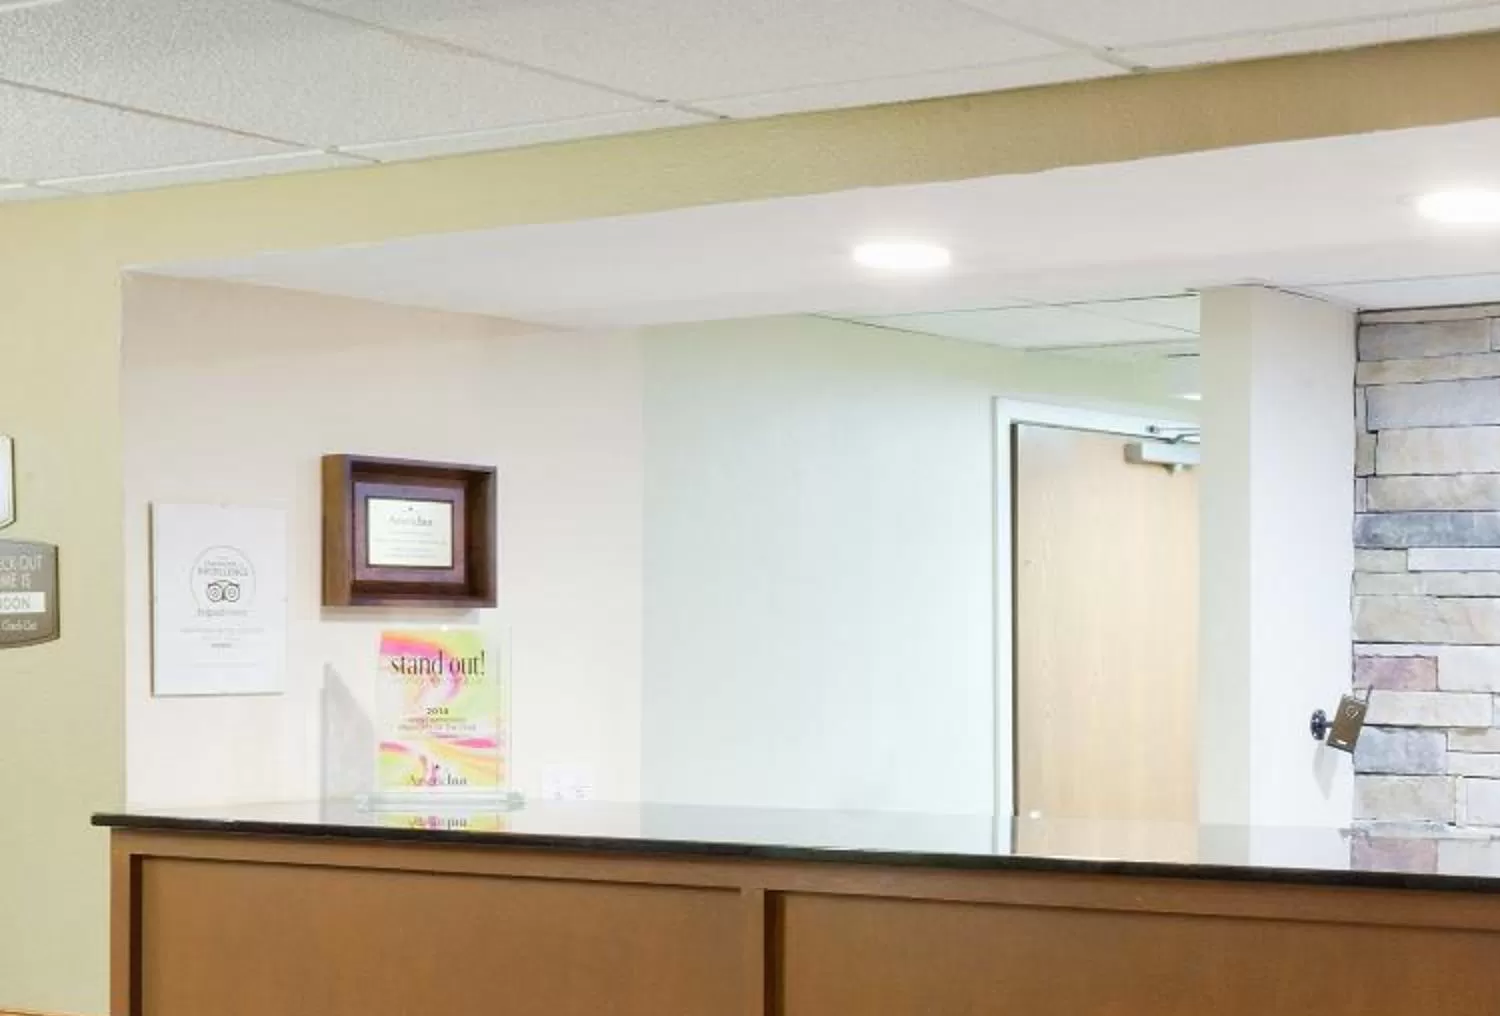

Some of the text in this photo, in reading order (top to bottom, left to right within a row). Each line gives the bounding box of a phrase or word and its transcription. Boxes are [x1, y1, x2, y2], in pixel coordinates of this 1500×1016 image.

[20, 554, 43, 571] OUT
[390, 648, 485, 676] stand out!
